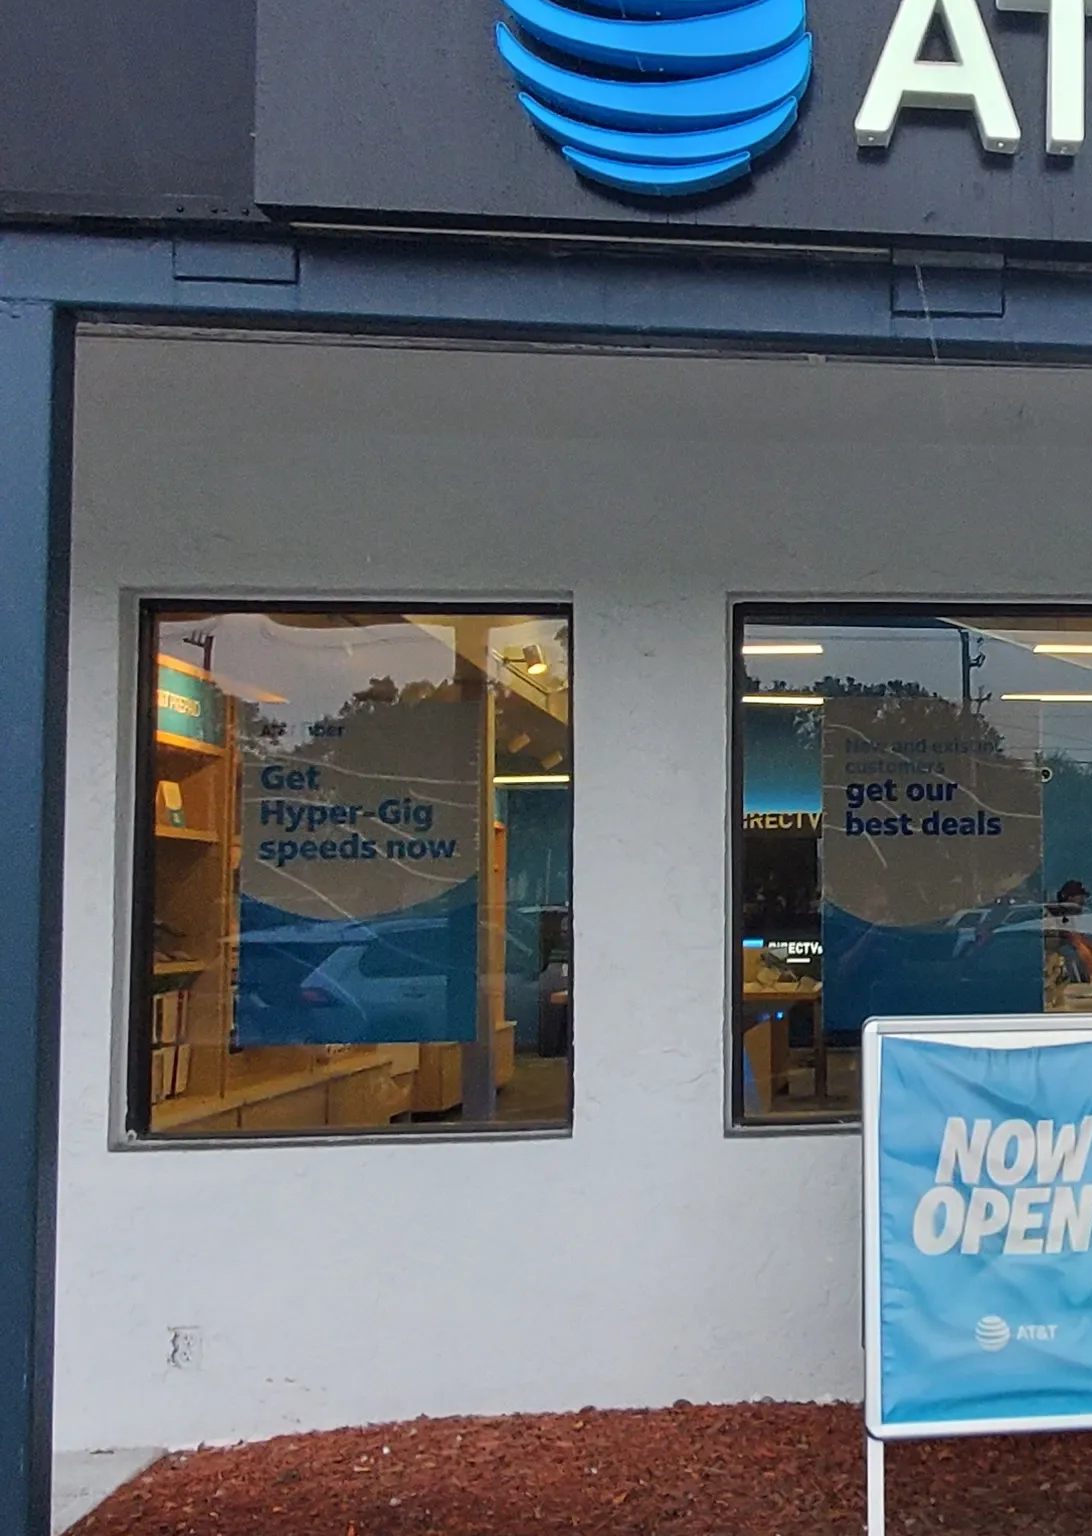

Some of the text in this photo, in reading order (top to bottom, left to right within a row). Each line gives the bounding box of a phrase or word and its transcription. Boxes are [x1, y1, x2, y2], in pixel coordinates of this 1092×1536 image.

[893, 737, 927, 754] and
[260, 765, 321, 791] Get
[845, 779, 958, 809] get our
[259, 797, 434, 832] Hyper-Gig
[743, 811, 821, 830] IRECTV
[845, 811, 1002, 837] best deals
[258, 833, 456, 867] speeds now
[1016, 1324, 1058, 1341] AT&T
